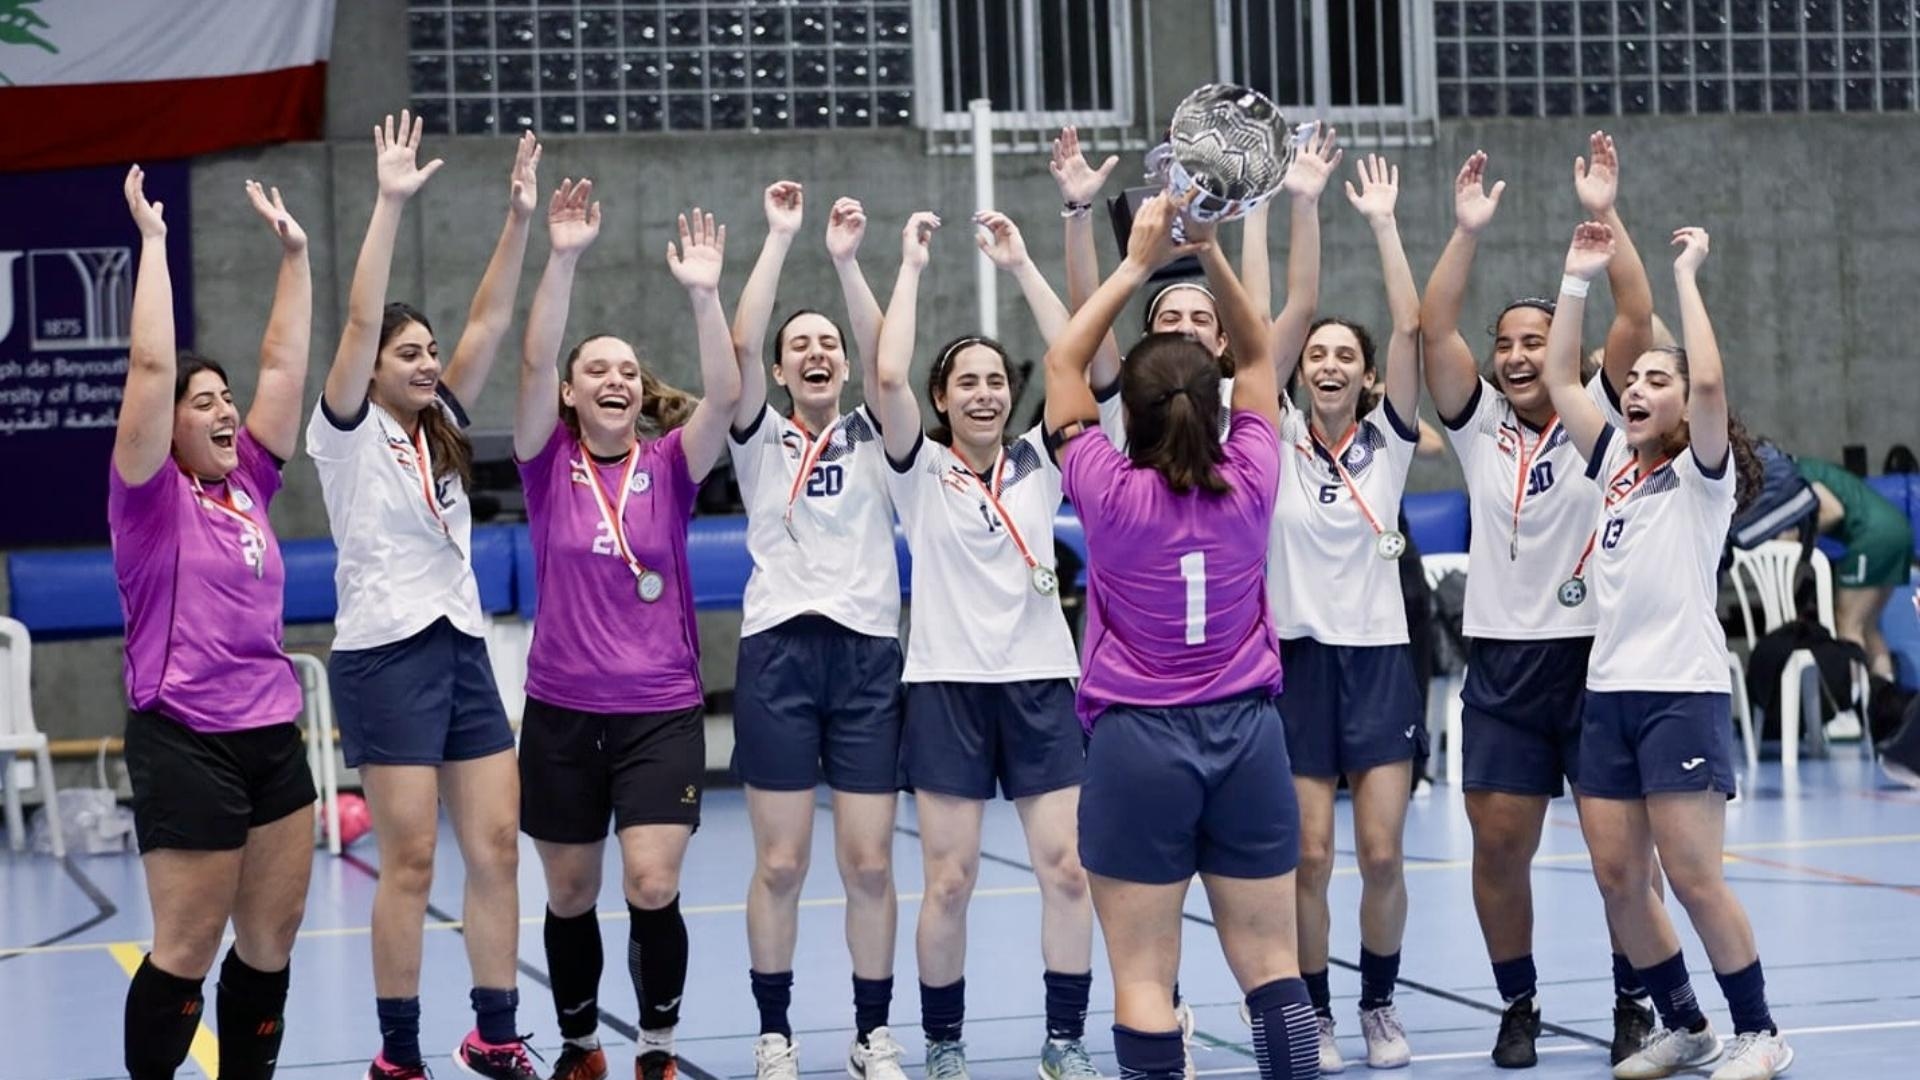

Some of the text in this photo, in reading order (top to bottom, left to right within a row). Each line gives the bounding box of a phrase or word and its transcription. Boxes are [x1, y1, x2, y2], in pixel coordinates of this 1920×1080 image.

[25, 359, 50, 377] de
[48, 384, 69, 403] of
[75, 383, 123, 403] Beiru
[806, 464, 843, 497] 20
[1318, 484, 1339, 505] 6
[1602, 518, 1625, 550] 13
[1180, 551, 1207, 646] 1
